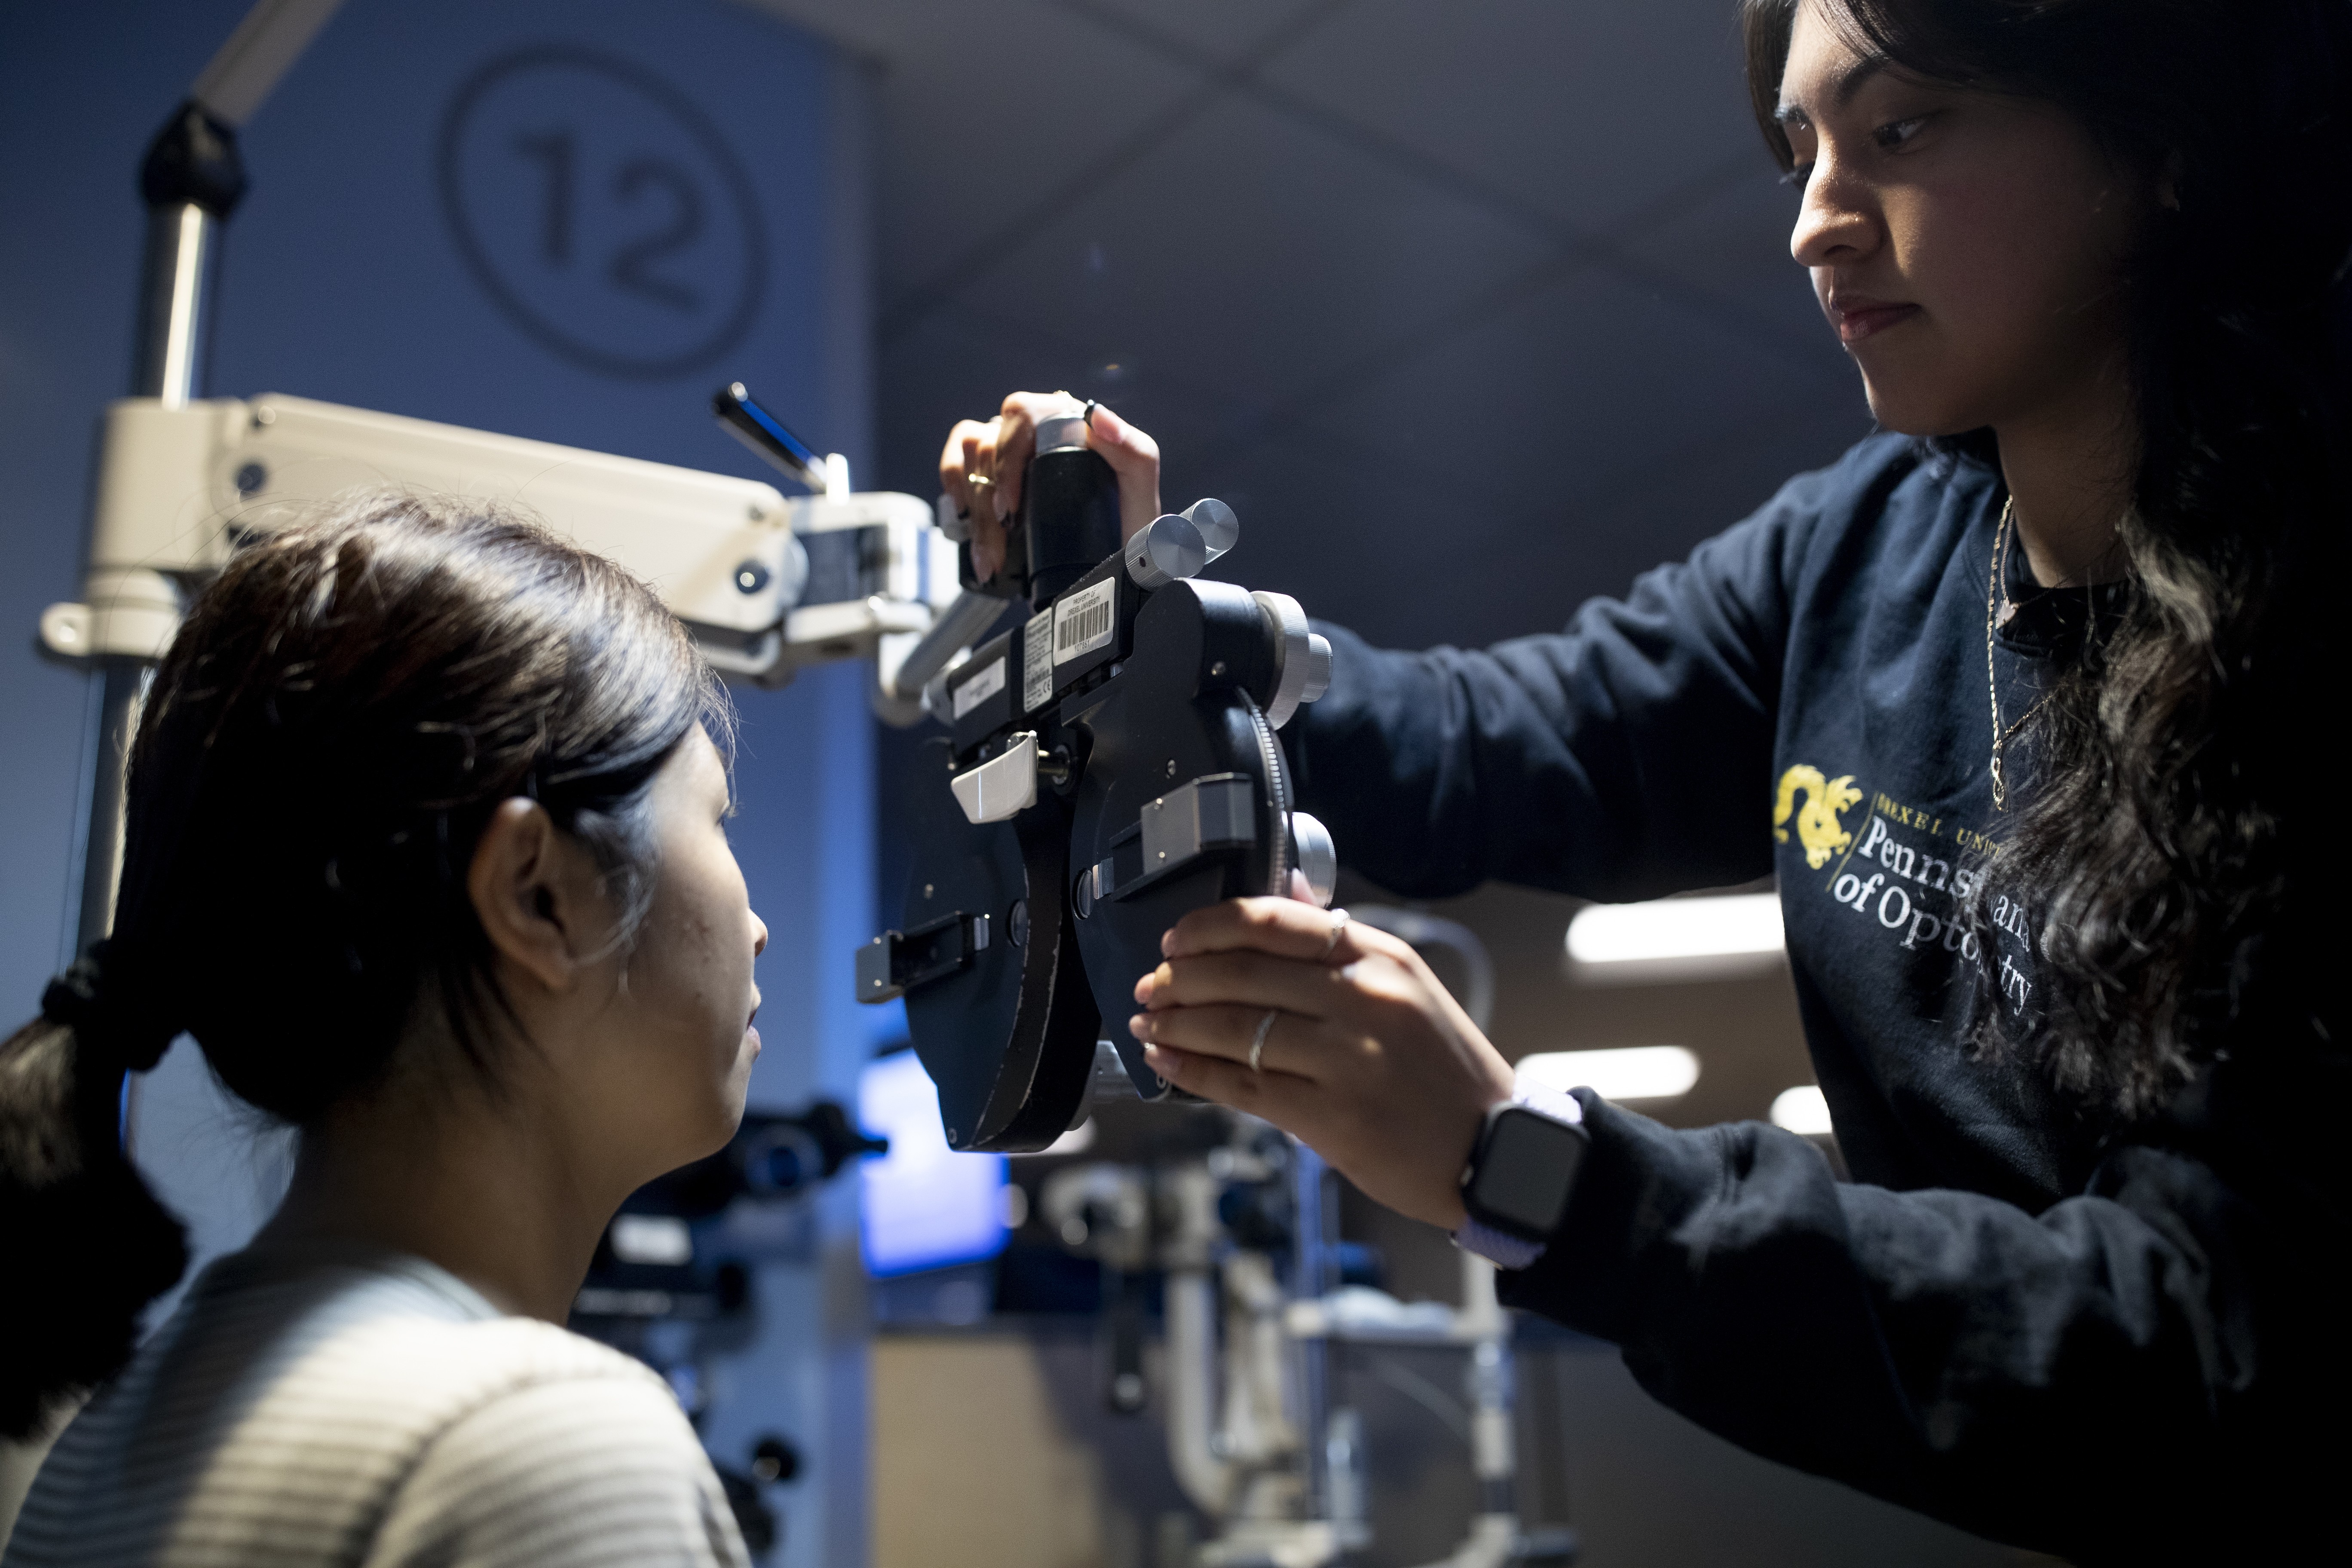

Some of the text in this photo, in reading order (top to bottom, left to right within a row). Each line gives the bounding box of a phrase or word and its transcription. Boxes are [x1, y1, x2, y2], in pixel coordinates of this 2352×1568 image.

[511, 126, 707, 313] 12
[1073, 592, 1090, 606] PROPERTY
[1081, 595, 1101, 610] UNIVERSITY
[1834, 873, 1885, 913] of
